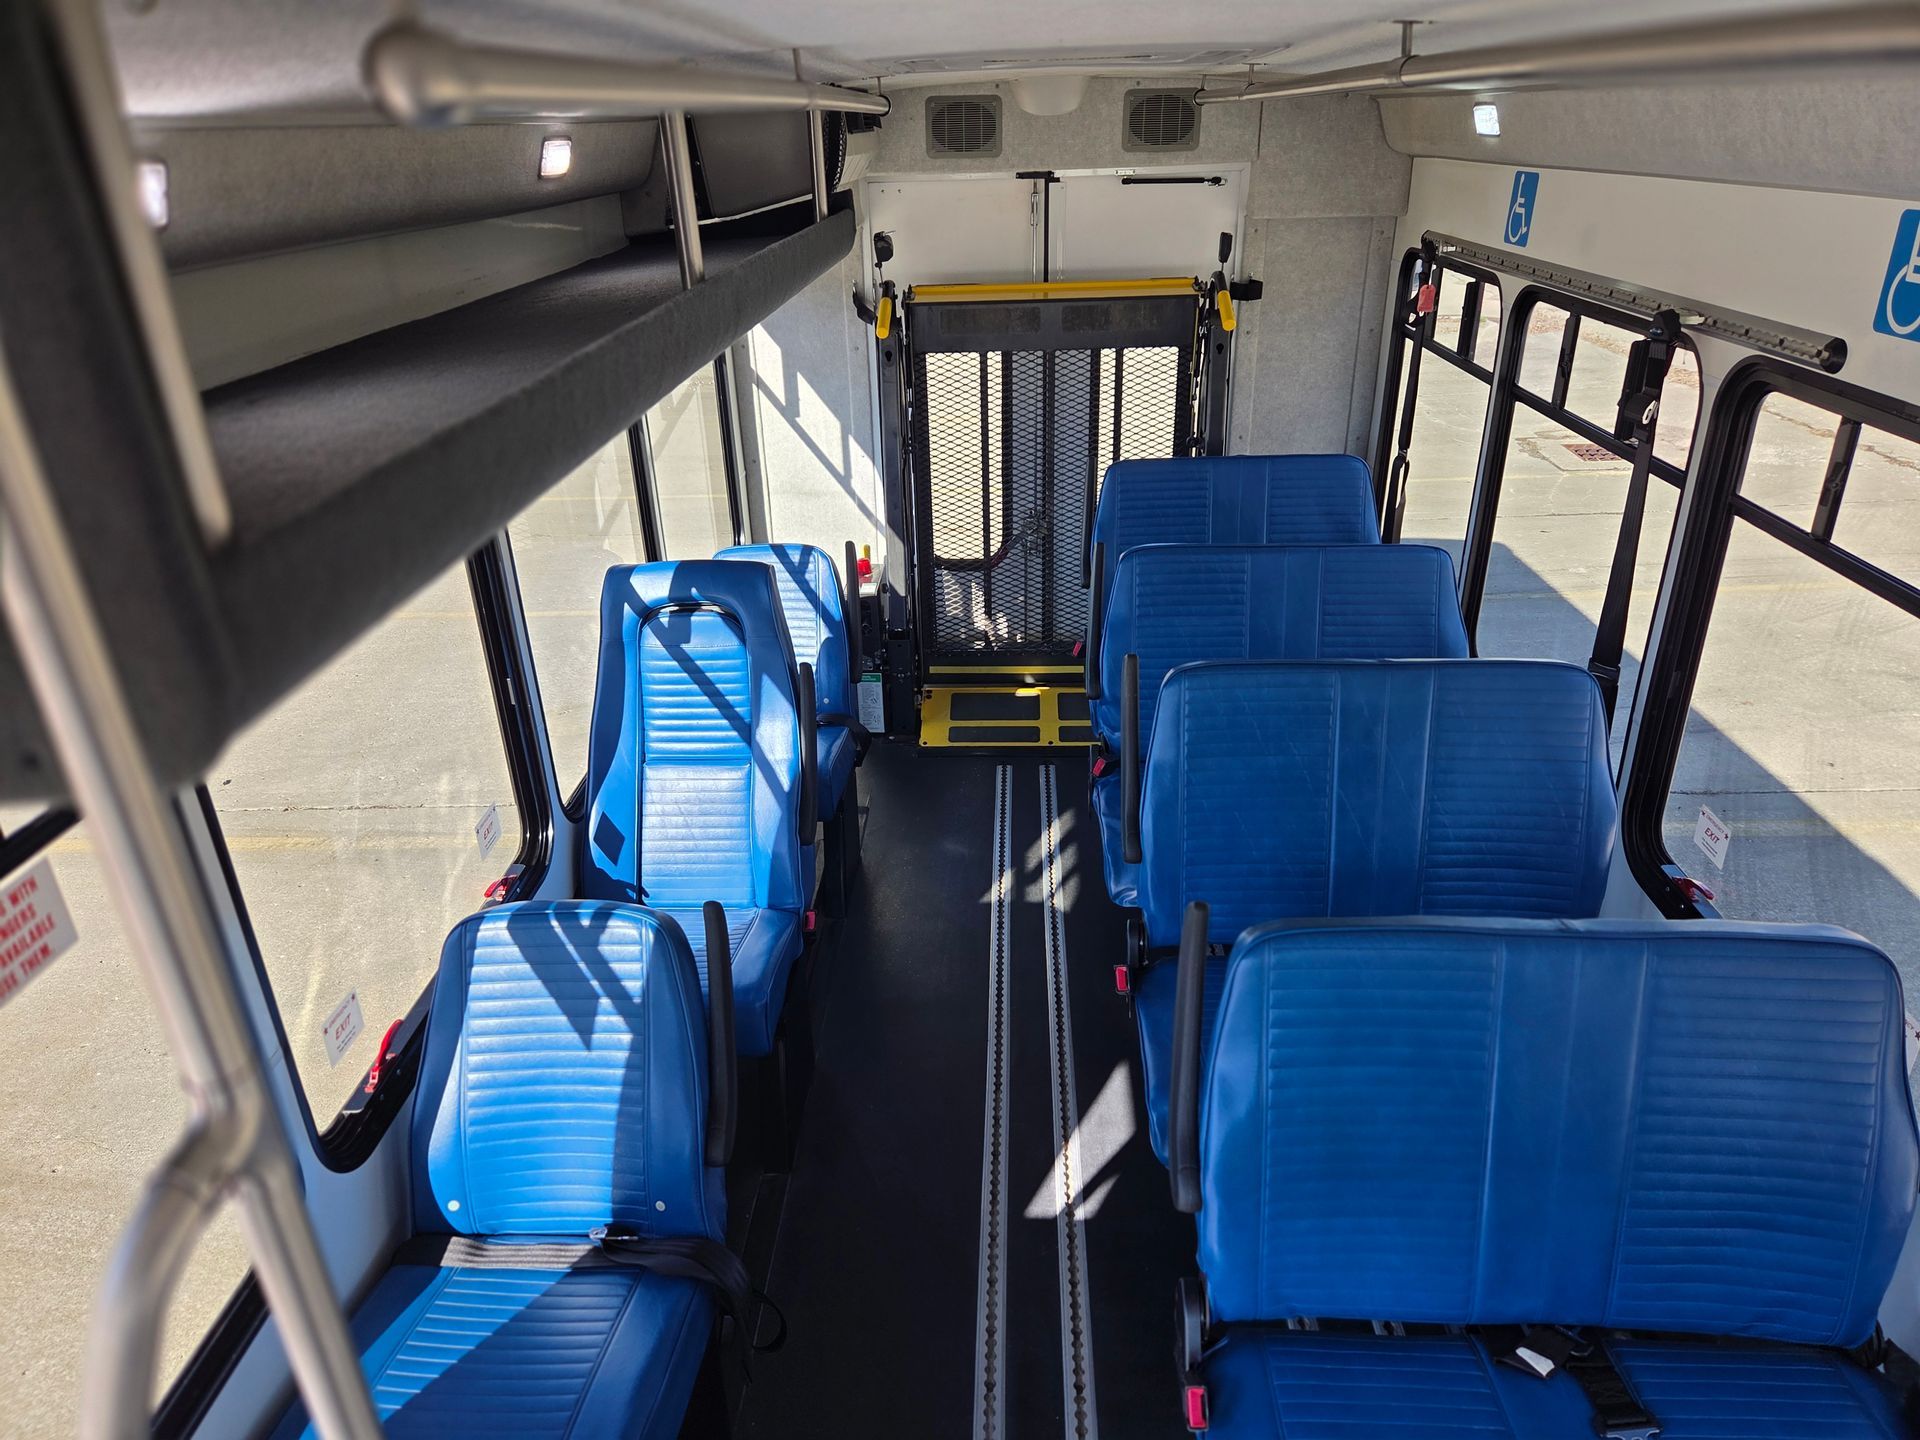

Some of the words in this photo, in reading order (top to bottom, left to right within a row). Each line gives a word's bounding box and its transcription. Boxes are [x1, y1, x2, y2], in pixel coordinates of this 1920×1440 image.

[1704, 827, 1720, 844] EXIT
[7, 875, 38, 908] WITH
[335, 1012, 351, 1040] EXIT
